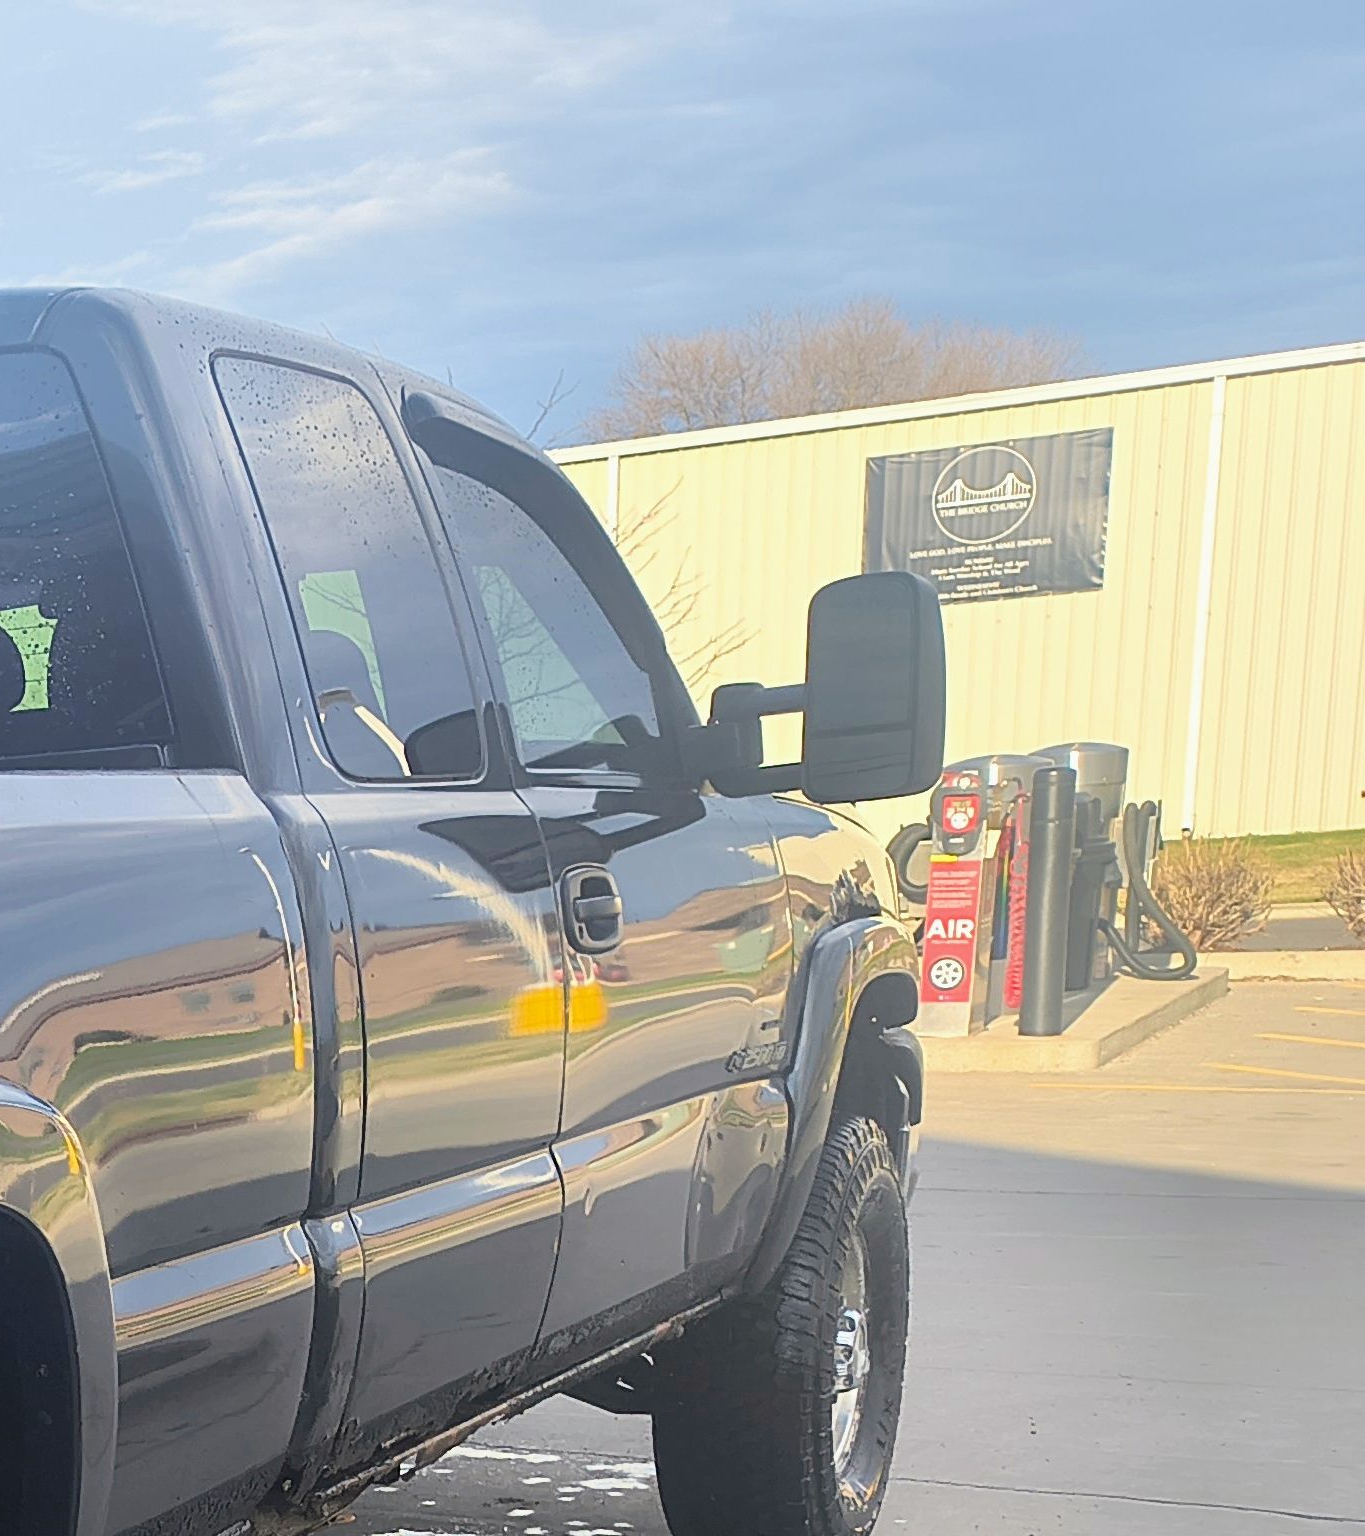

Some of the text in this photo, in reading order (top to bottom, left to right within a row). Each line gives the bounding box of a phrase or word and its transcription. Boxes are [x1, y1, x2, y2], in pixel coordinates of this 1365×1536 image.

[939, 508, 956, 518] THE
[989, 500, 1028, 512] CHURCH
[926, 918, 975, 940] AIR
